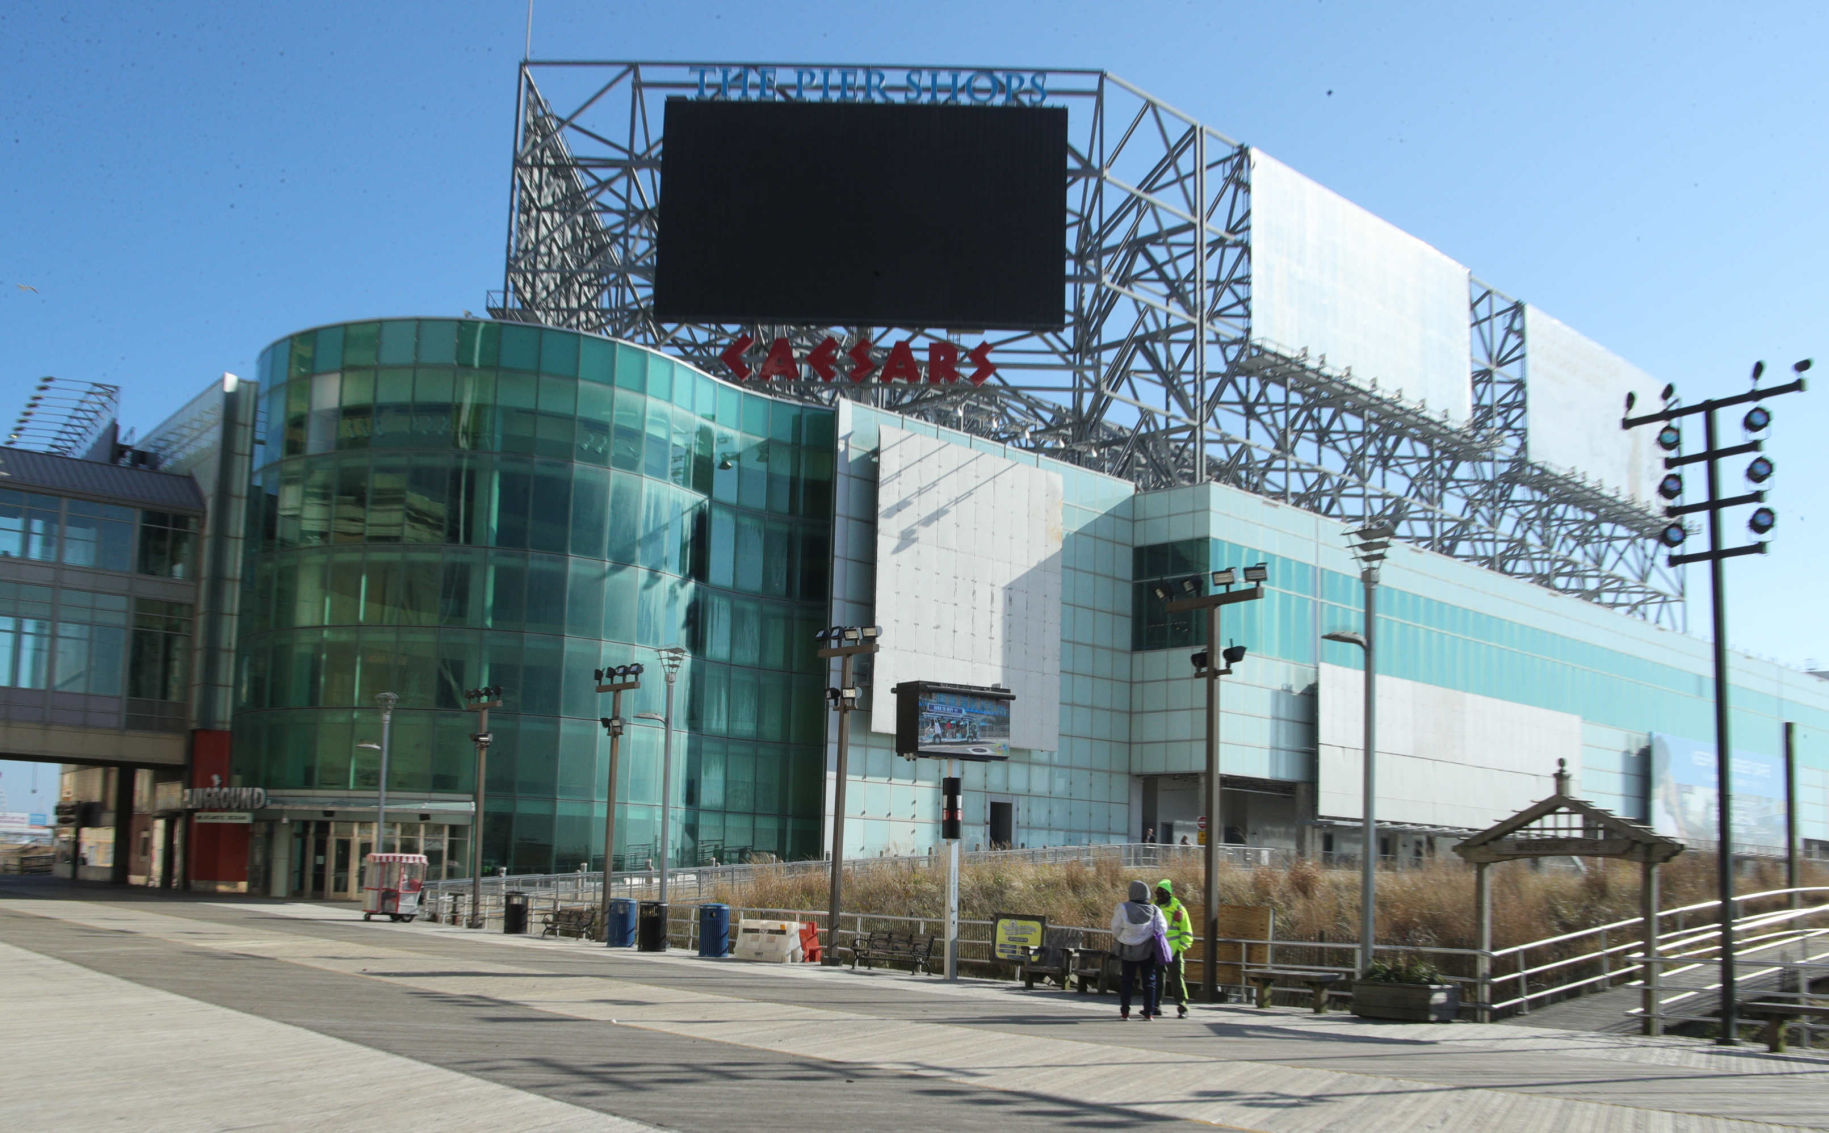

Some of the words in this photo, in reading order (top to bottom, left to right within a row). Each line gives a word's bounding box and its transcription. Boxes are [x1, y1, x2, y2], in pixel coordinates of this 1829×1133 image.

[689, 65, 777, 102] THE
[794, 67, 895, 104] PIER
[904, 69, 1048, 107] SHOPS
[720, 333, 997, 388] CAESARS
